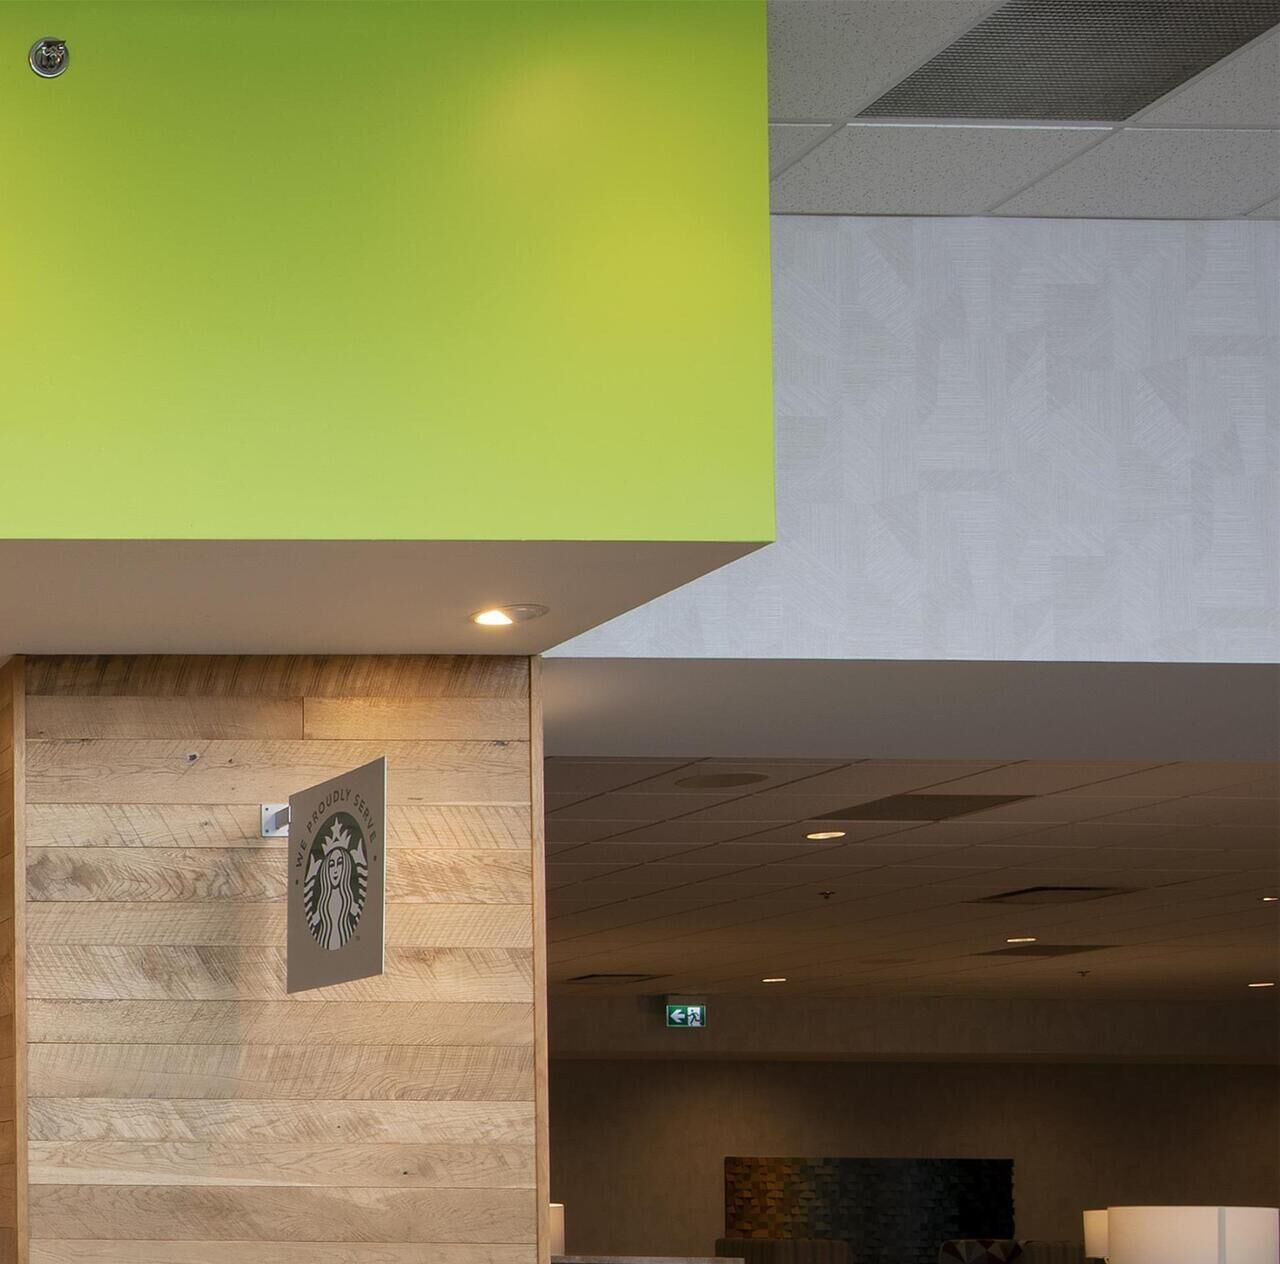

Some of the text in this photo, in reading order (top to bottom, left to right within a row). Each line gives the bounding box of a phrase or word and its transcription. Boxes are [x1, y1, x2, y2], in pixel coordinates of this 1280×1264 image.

[296, 788, 376, 868] WE PROUDLY SERVE
